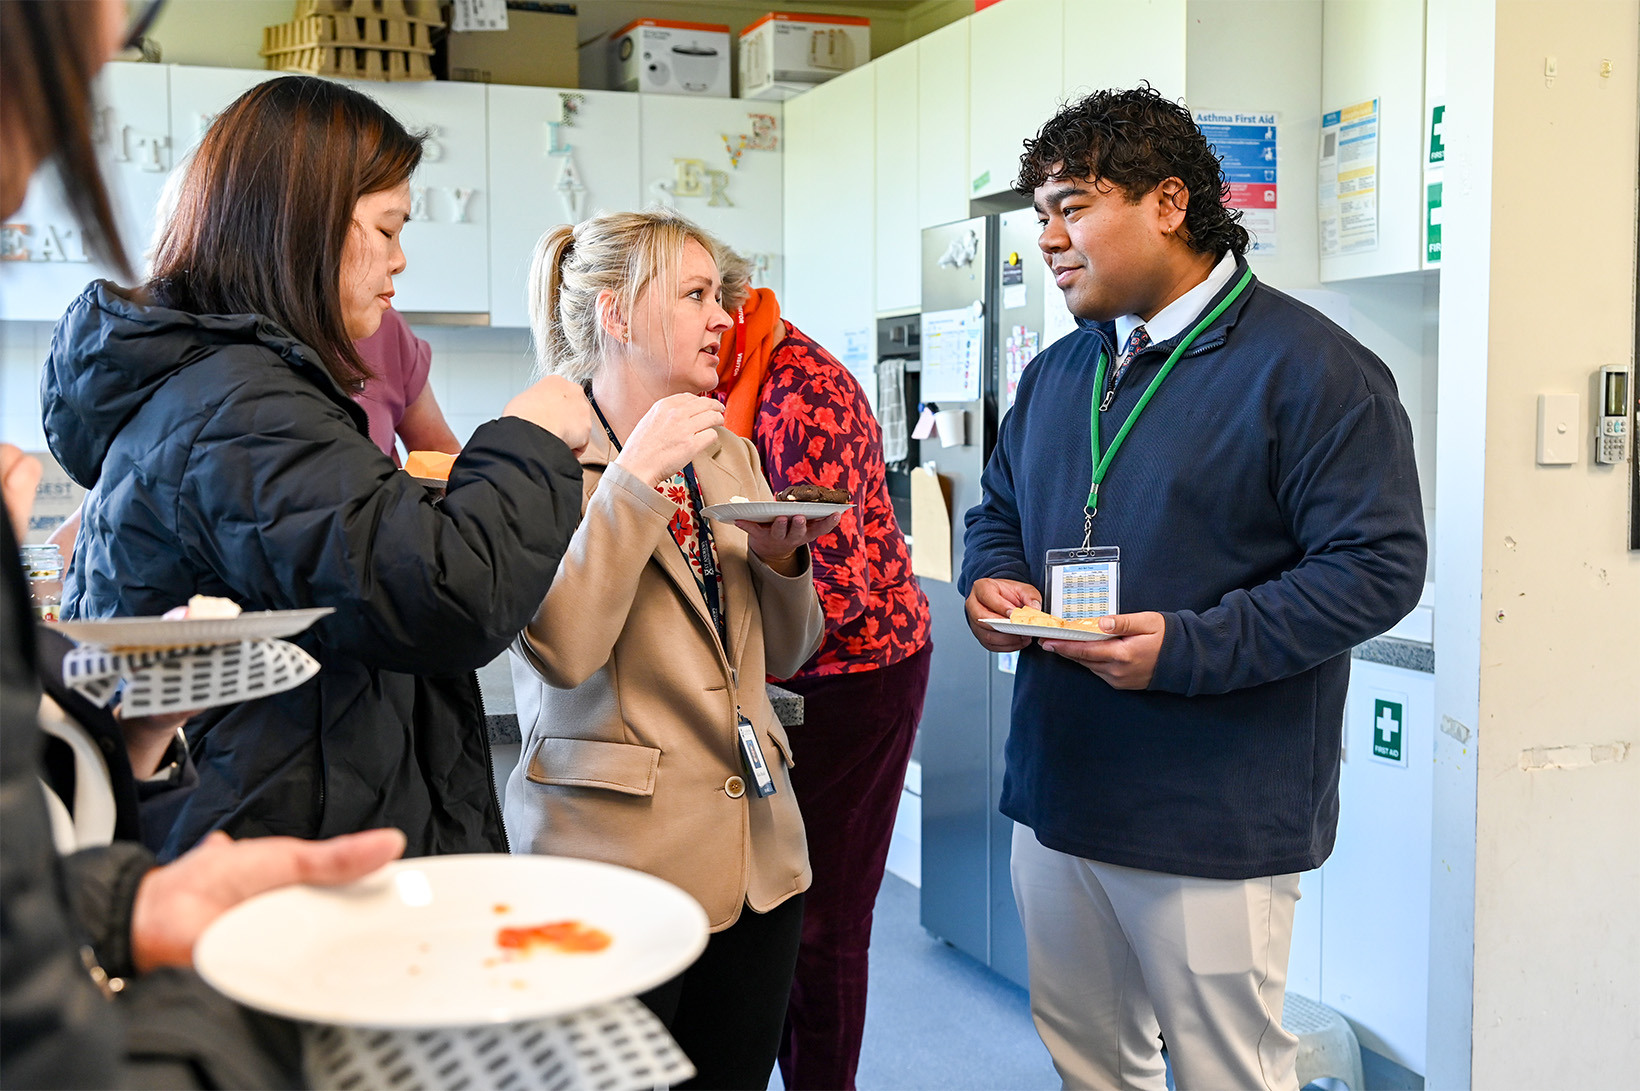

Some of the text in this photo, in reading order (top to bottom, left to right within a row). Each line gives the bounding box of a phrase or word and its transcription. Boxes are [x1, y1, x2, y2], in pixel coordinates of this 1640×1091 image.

[1197, 113, 1275, 125] Asthma First Aid
[1429, 242, 1442, 253] FIR
[734, 352, 743, 376] VISITOR
[1375, 745, 1400, 758] FIRST AID
